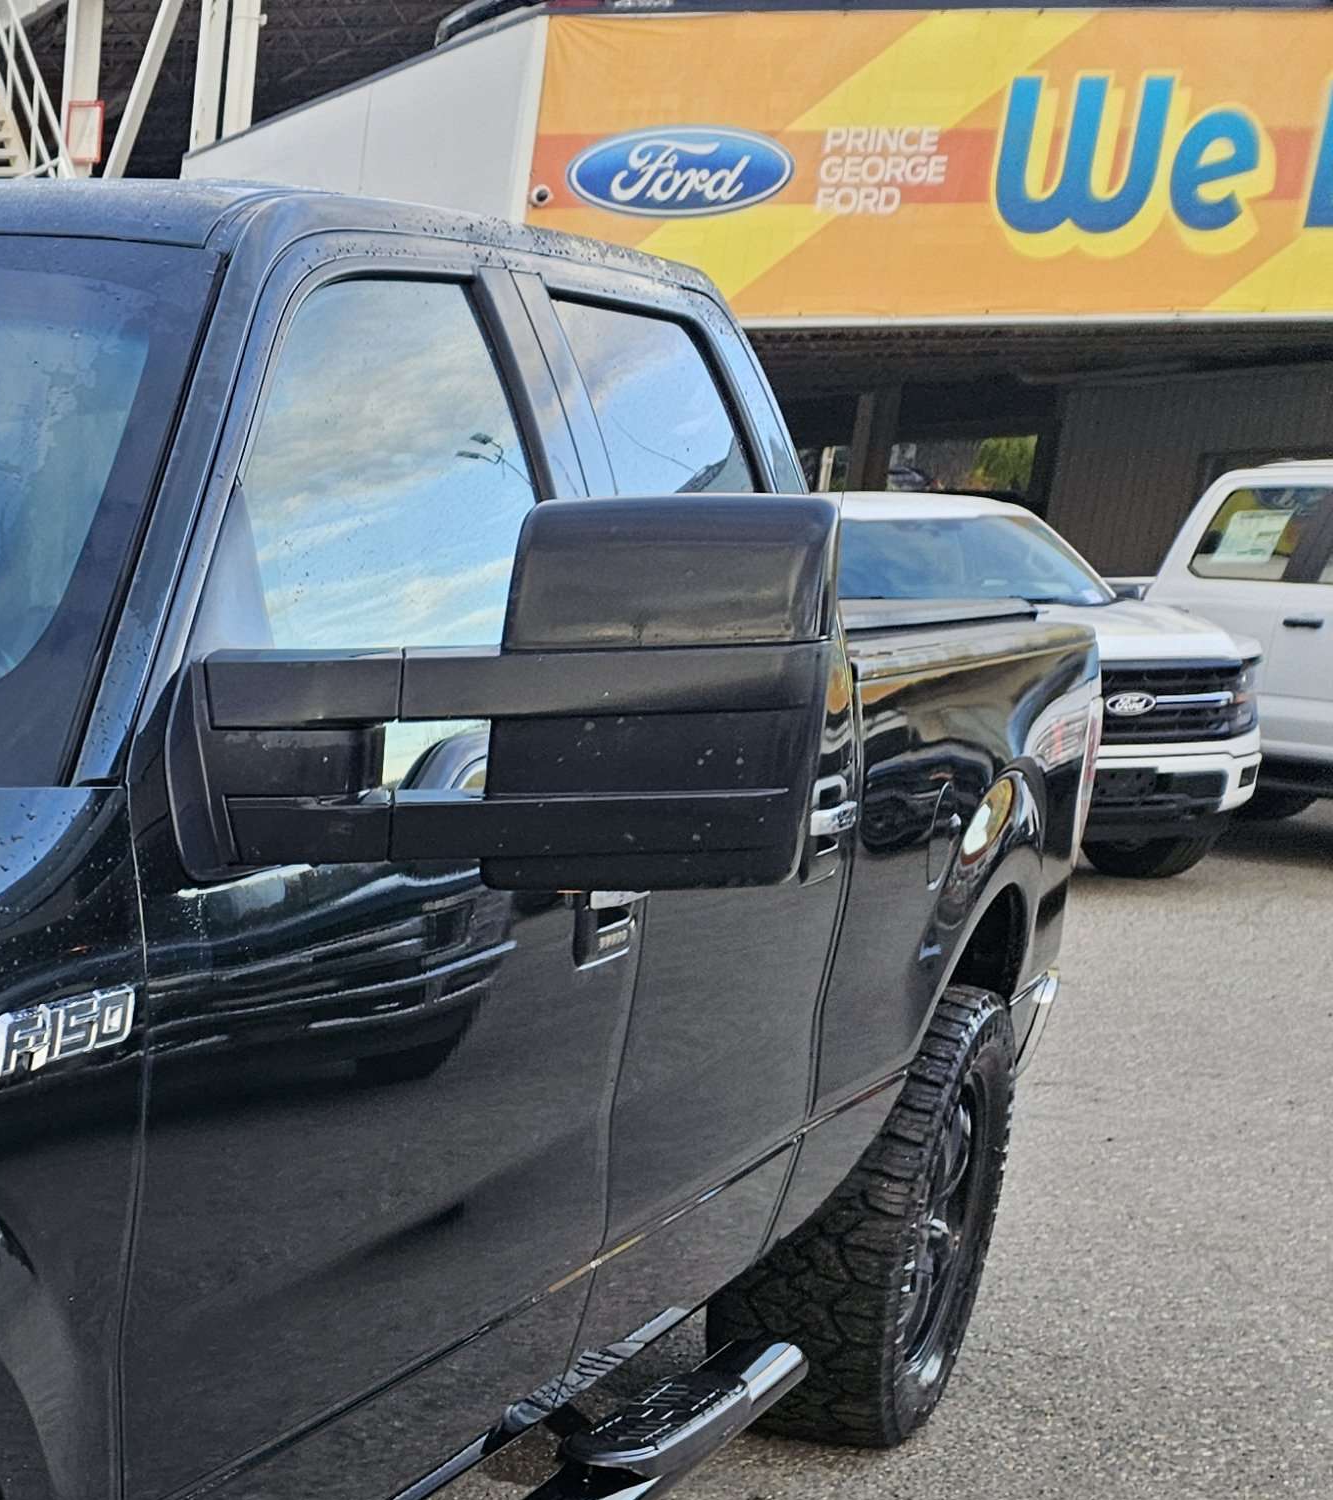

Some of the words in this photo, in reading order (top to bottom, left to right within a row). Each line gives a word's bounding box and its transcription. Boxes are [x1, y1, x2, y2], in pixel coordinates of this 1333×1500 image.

[823, 125, 942, 154] PRINCE
[994, 73, 1262, 236] We
[610, 139, 752, 203] Ford
[819, 154, 948, 185] GEORGE
[814, 185, 903, 216] FORD
